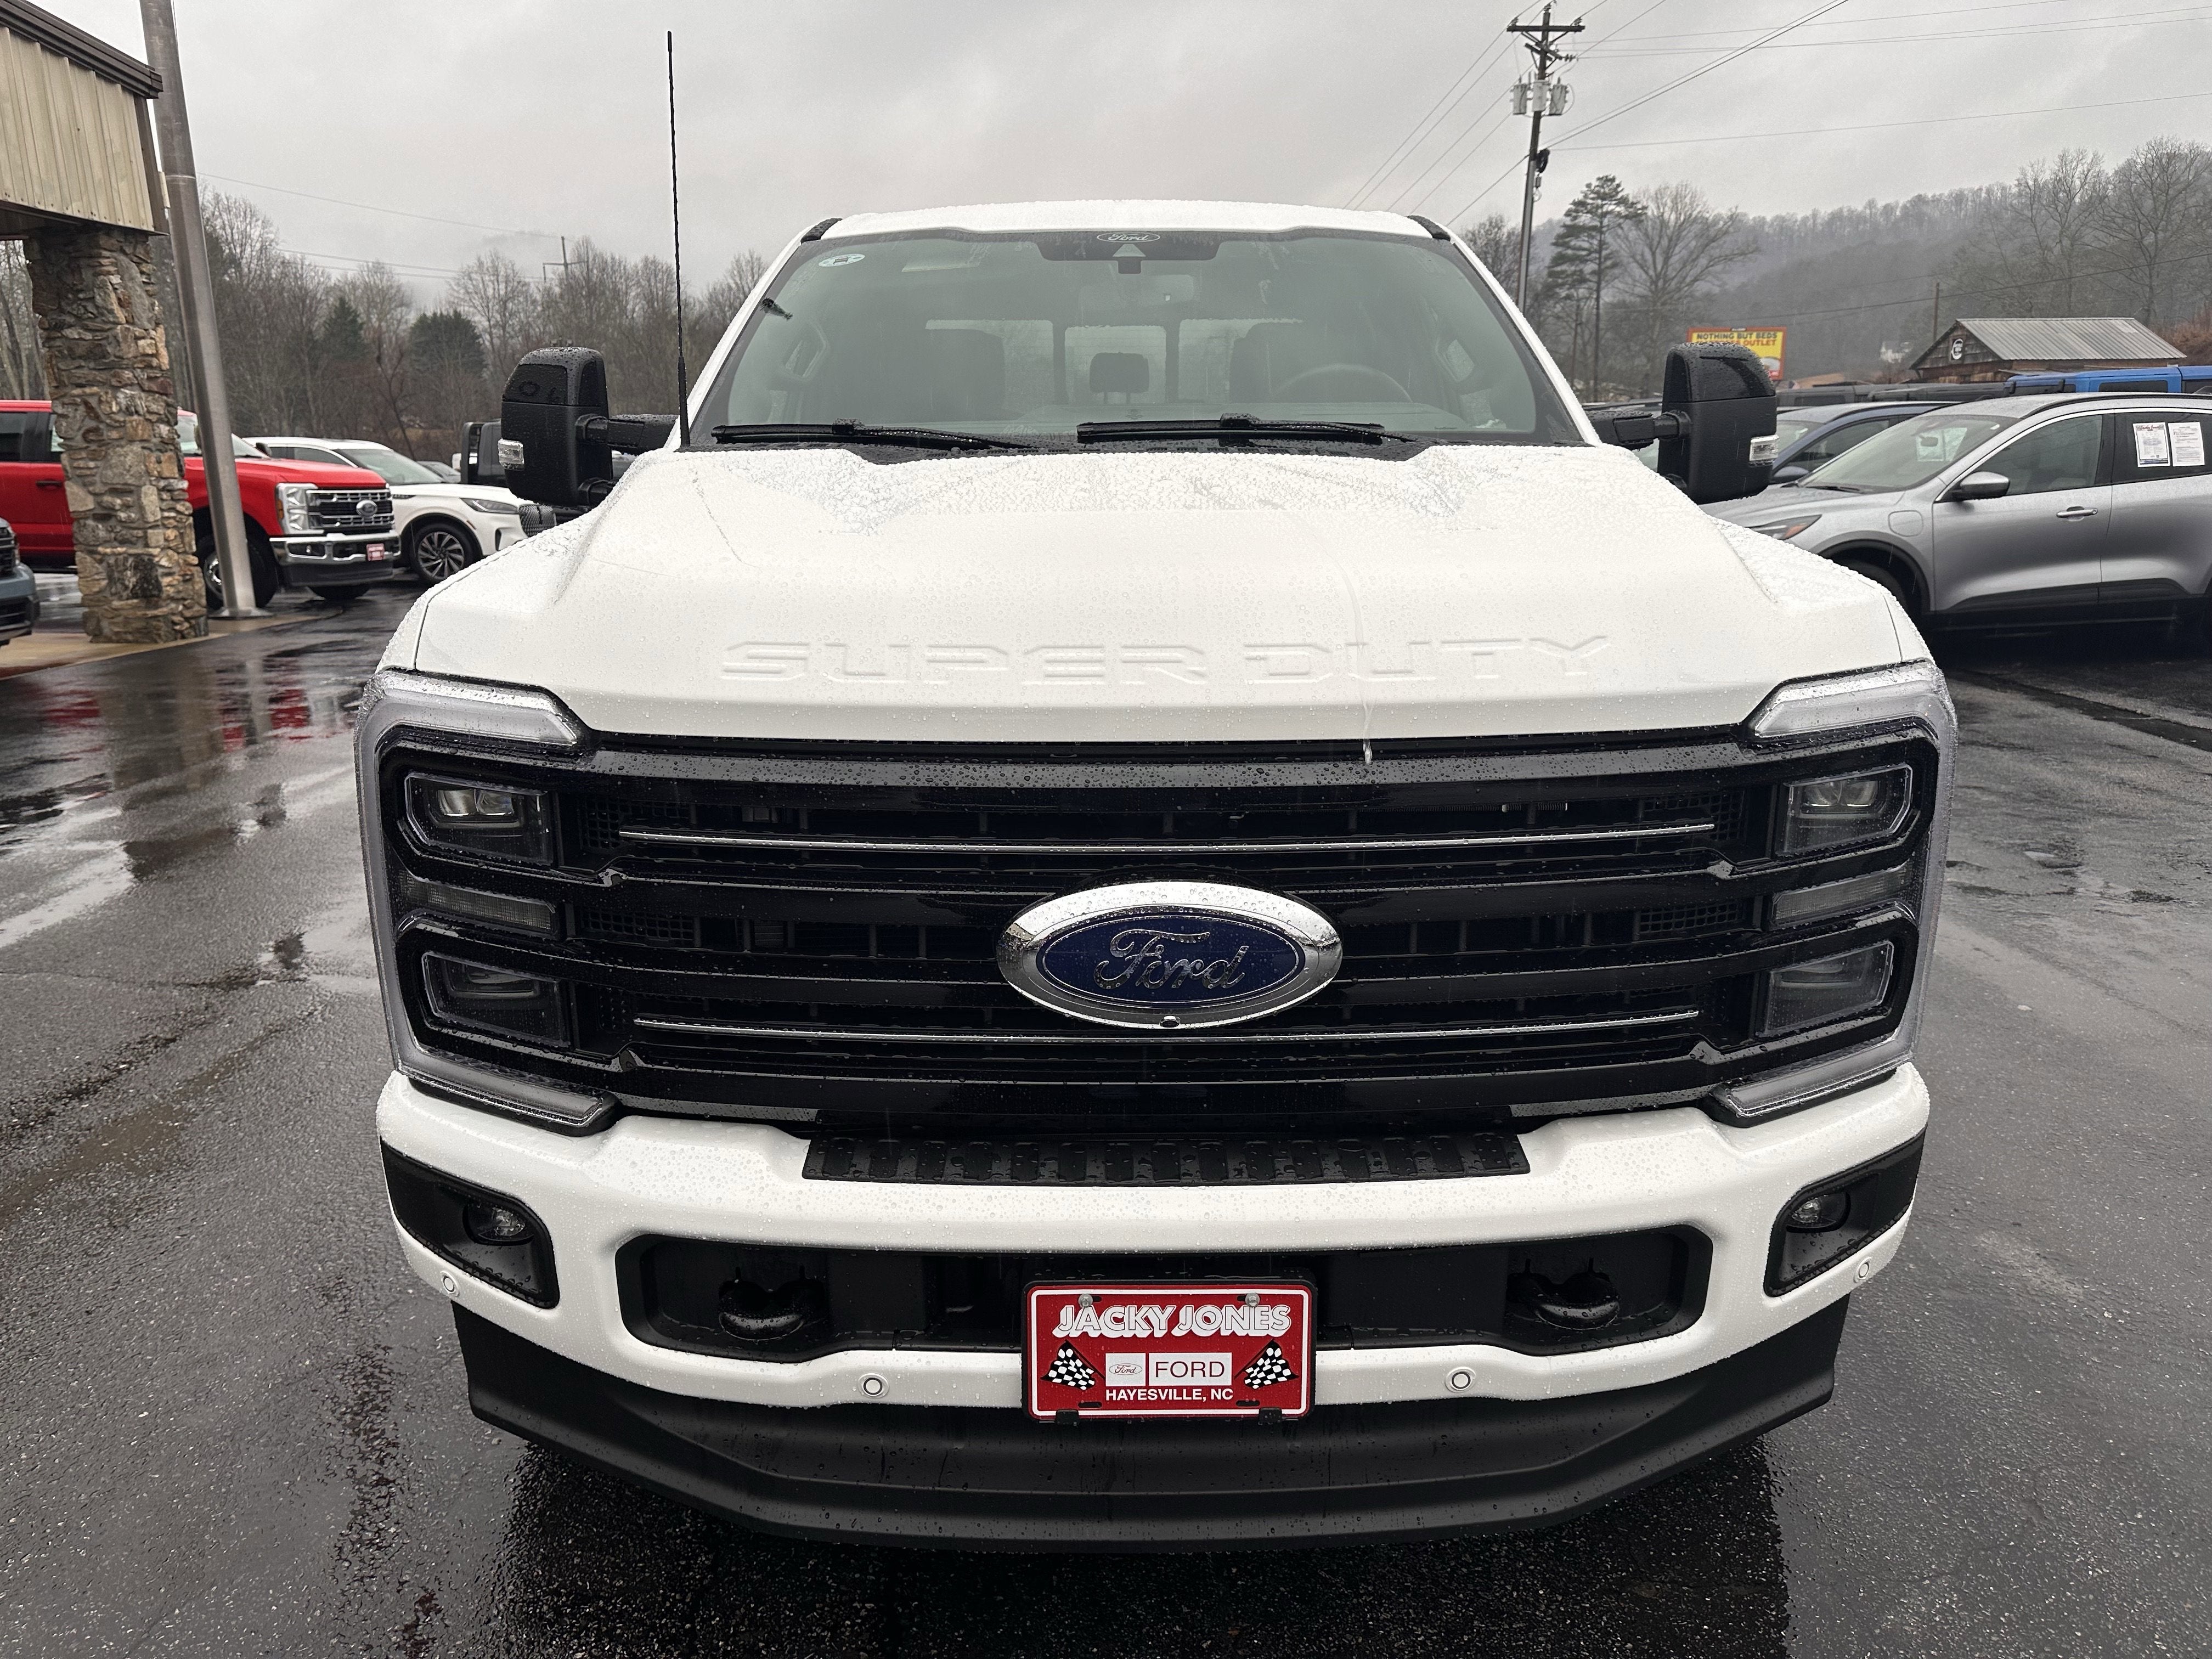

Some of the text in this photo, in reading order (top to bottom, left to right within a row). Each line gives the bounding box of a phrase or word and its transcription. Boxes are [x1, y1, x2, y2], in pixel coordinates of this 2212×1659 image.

[720, 635, 1612, 685] SUPER DUTY
[1093, 928, 1250, 990] Ford
[1052, 1305, 1292, 1339] JACKY JONES
[1114, 1364, 1137, 1374] Ford
[1155, 1361, 1225, 1378] FORD
[1105, 1388, 1234, 1402] HAYESVILLE, NC
